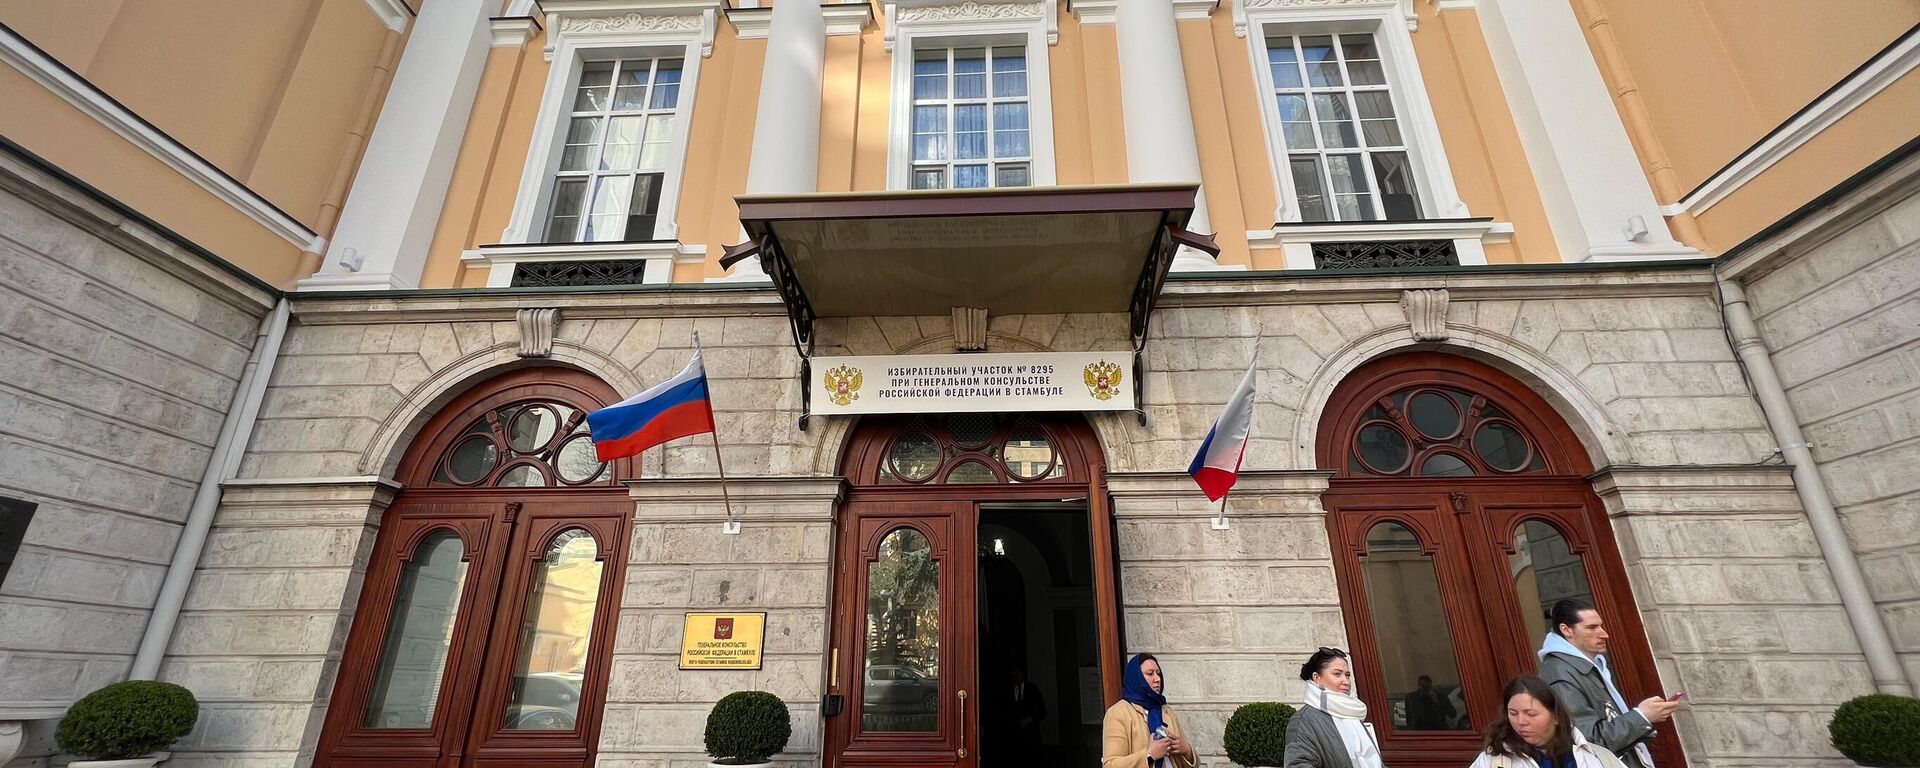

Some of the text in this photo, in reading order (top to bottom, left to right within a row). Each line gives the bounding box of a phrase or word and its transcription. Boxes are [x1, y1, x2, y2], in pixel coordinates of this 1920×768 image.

[887, 365, 1054, 376] ИЗБИРАТЕЛЬНЫЙ УЧАСТОК № 8295
[891, 376, 1050, 387] ПРИ ГЕНЕРАЛЬНОМ КОНСУЛЬСТВЕ
[879, 387, 1064, 398] РОССИЙСКОЙ ФЕДЕРАЦИИ В СТАМБУЛЕ
